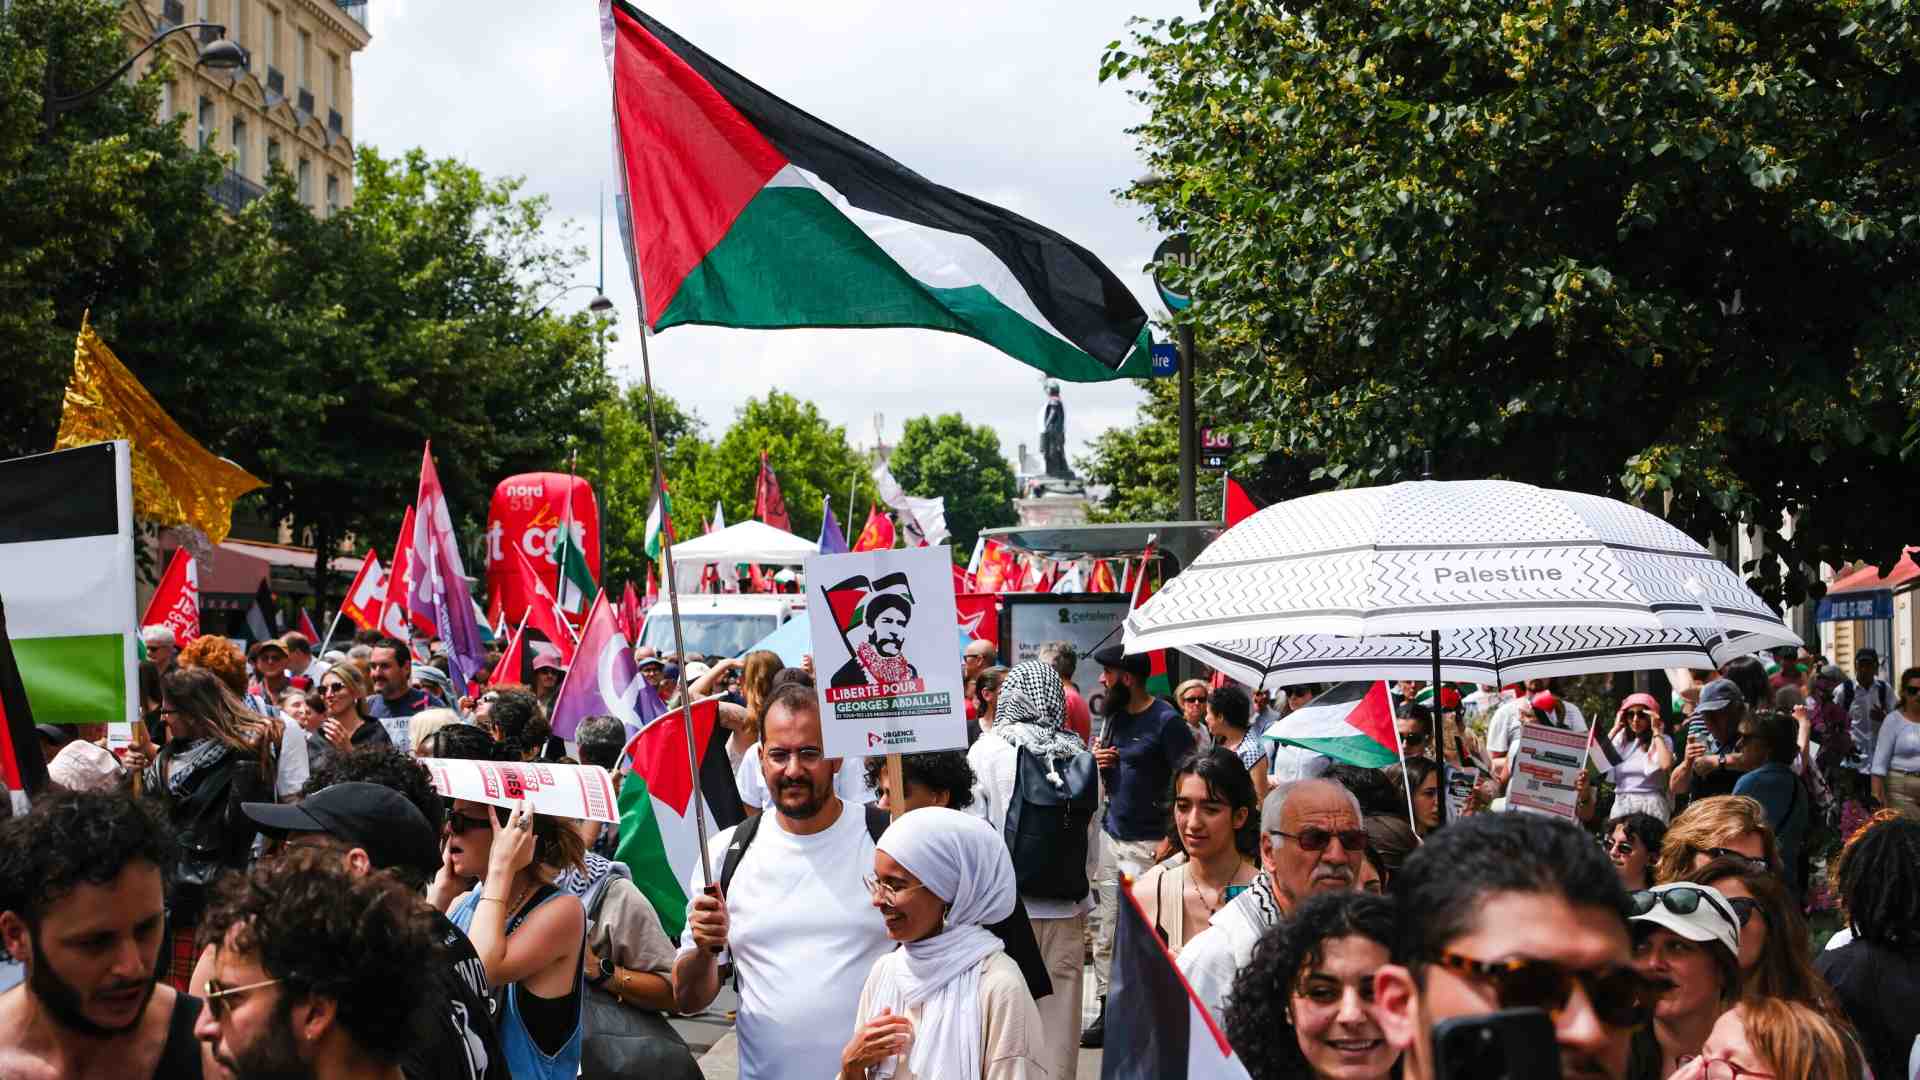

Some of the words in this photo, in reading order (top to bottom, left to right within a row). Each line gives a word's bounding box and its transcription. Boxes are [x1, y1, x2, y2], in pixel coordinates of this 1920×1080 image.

[506, 484, 544, 497] nord
[509, 496, 534, 511] 59
[1434, 565, 1562, 584] Palestine
[882, 681, 917, 696] POUR
[836, 700, 889, 712] GEORGES
[891, 695, 948, 709] ABDALLAH
[882, 730, 914, 738] URGENCE
